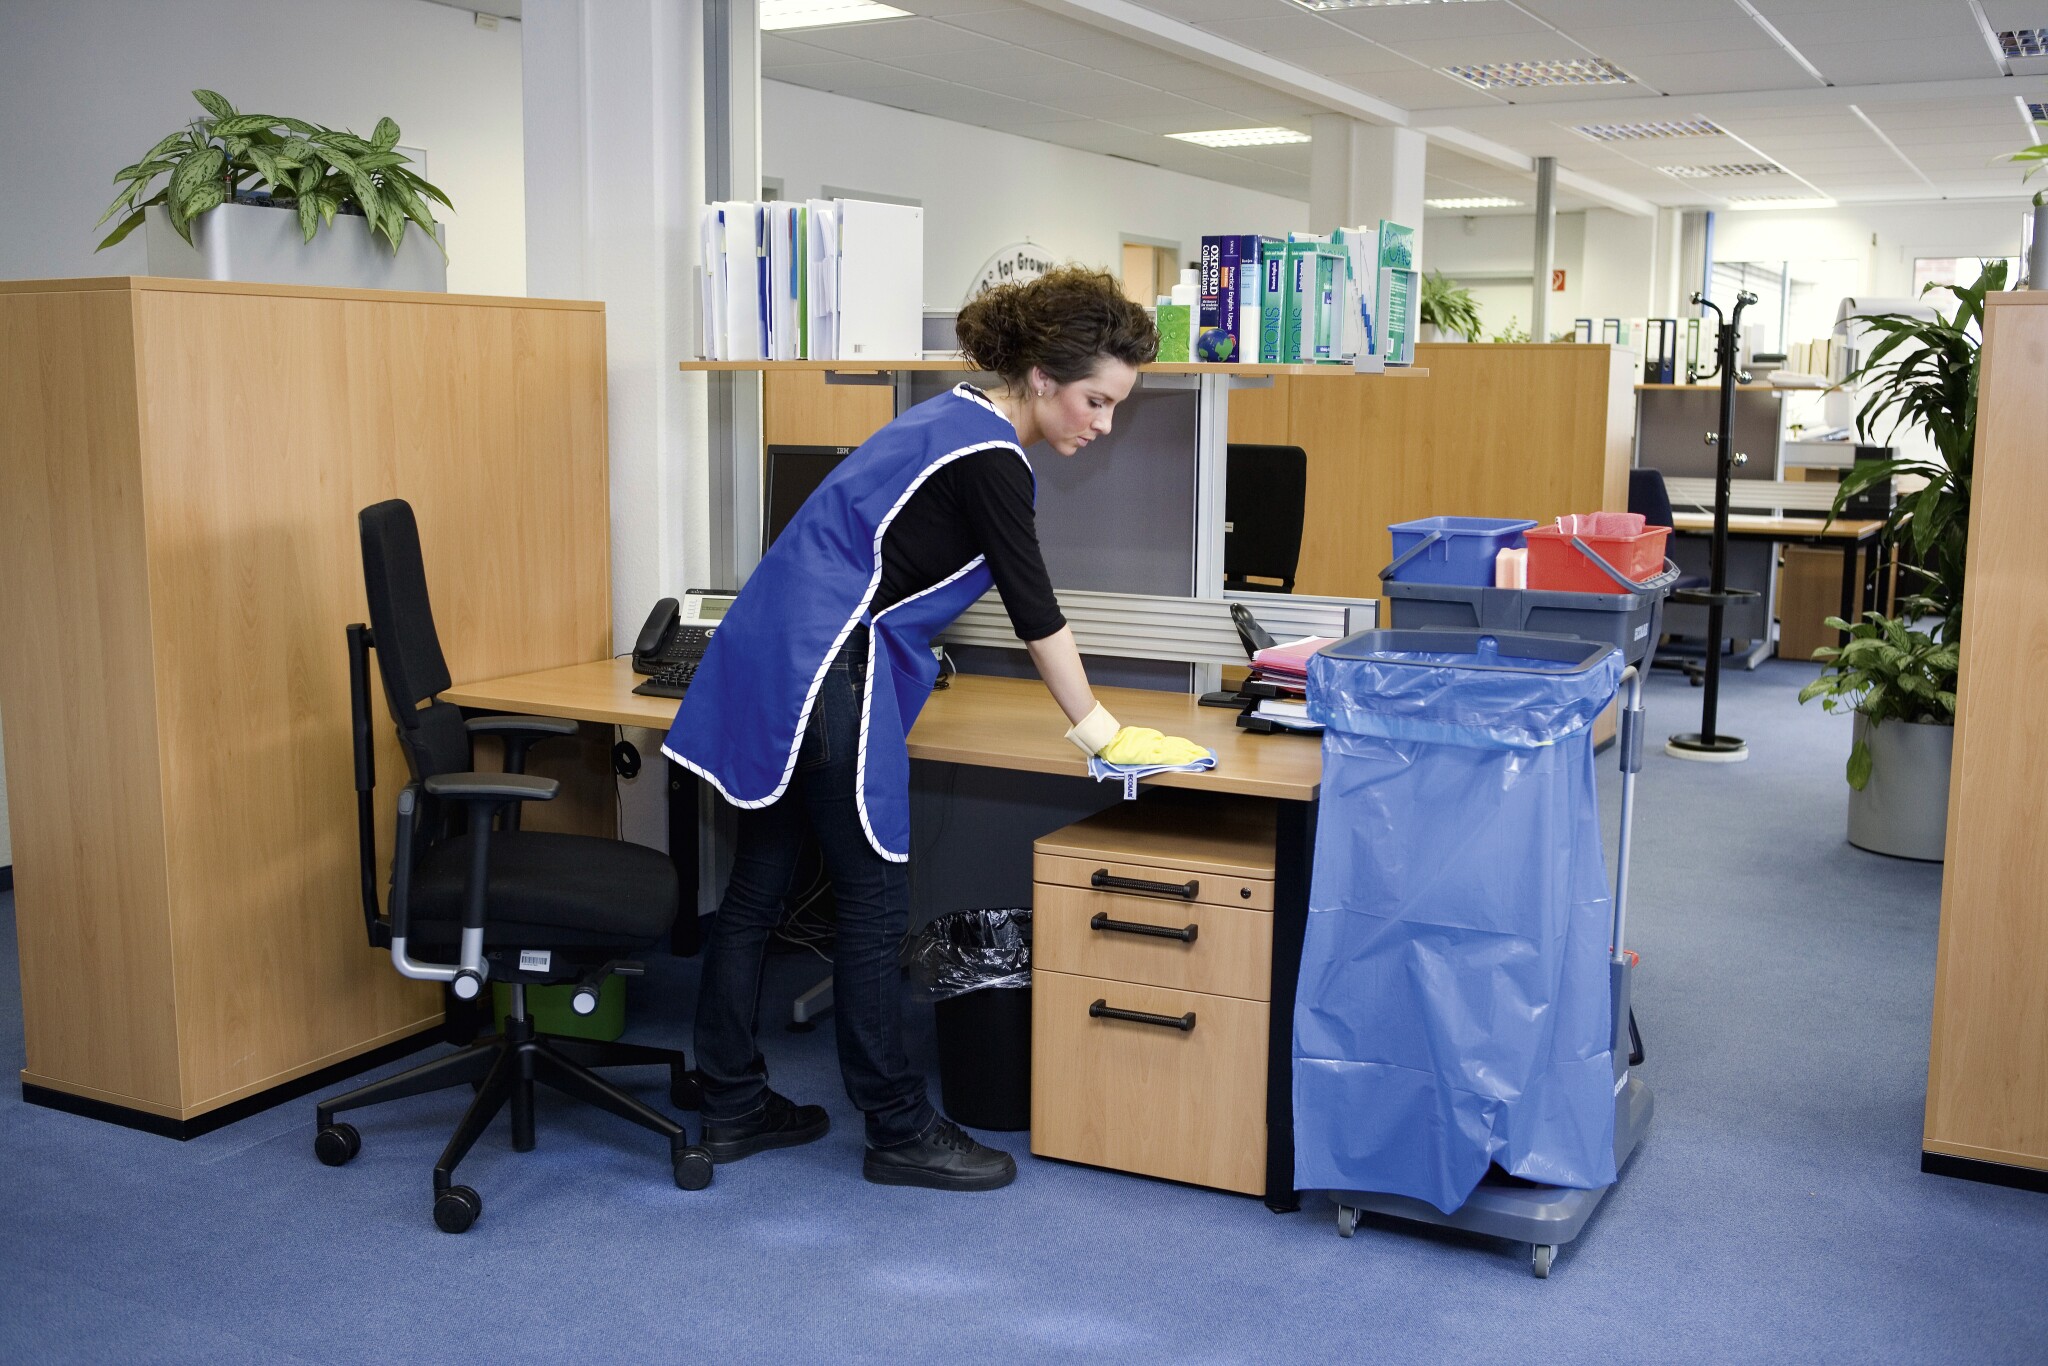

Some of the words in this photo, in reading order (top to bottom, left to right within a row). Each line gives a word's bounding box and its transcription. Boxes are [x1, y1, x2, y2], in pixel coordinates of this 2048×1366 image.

[1202, 244, 1210, 295] Collocations
[1210, 244, 1219, 295] OXFORD
[1227, 291, 1235, 312] English
[1226, 312, 1234, 331] Usage
[1264, 307, 1280, 353] PONS
[836, 447, 850, 455] IBM
